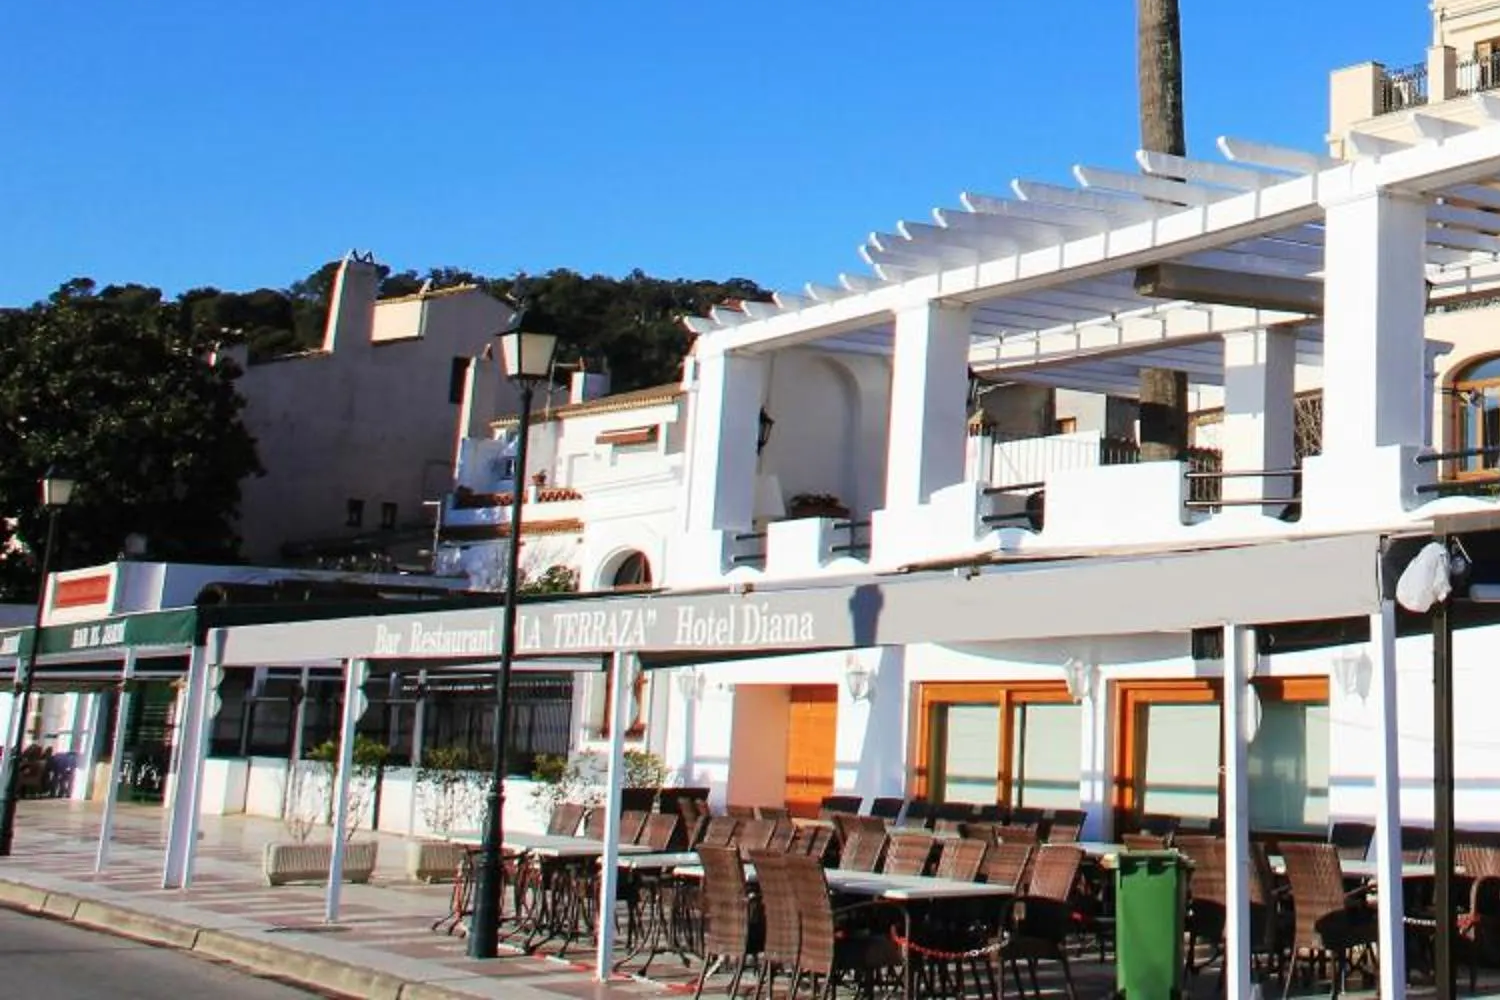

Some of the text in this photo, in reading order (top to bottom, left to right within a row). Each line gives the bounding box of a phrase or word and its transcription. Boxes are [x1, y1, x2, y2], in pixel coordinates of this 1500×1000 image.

[374, 624, 401, 654] Bar
[410, 622, 496, 652] Restaurant
[675, 604, 736, 646] Hotel
